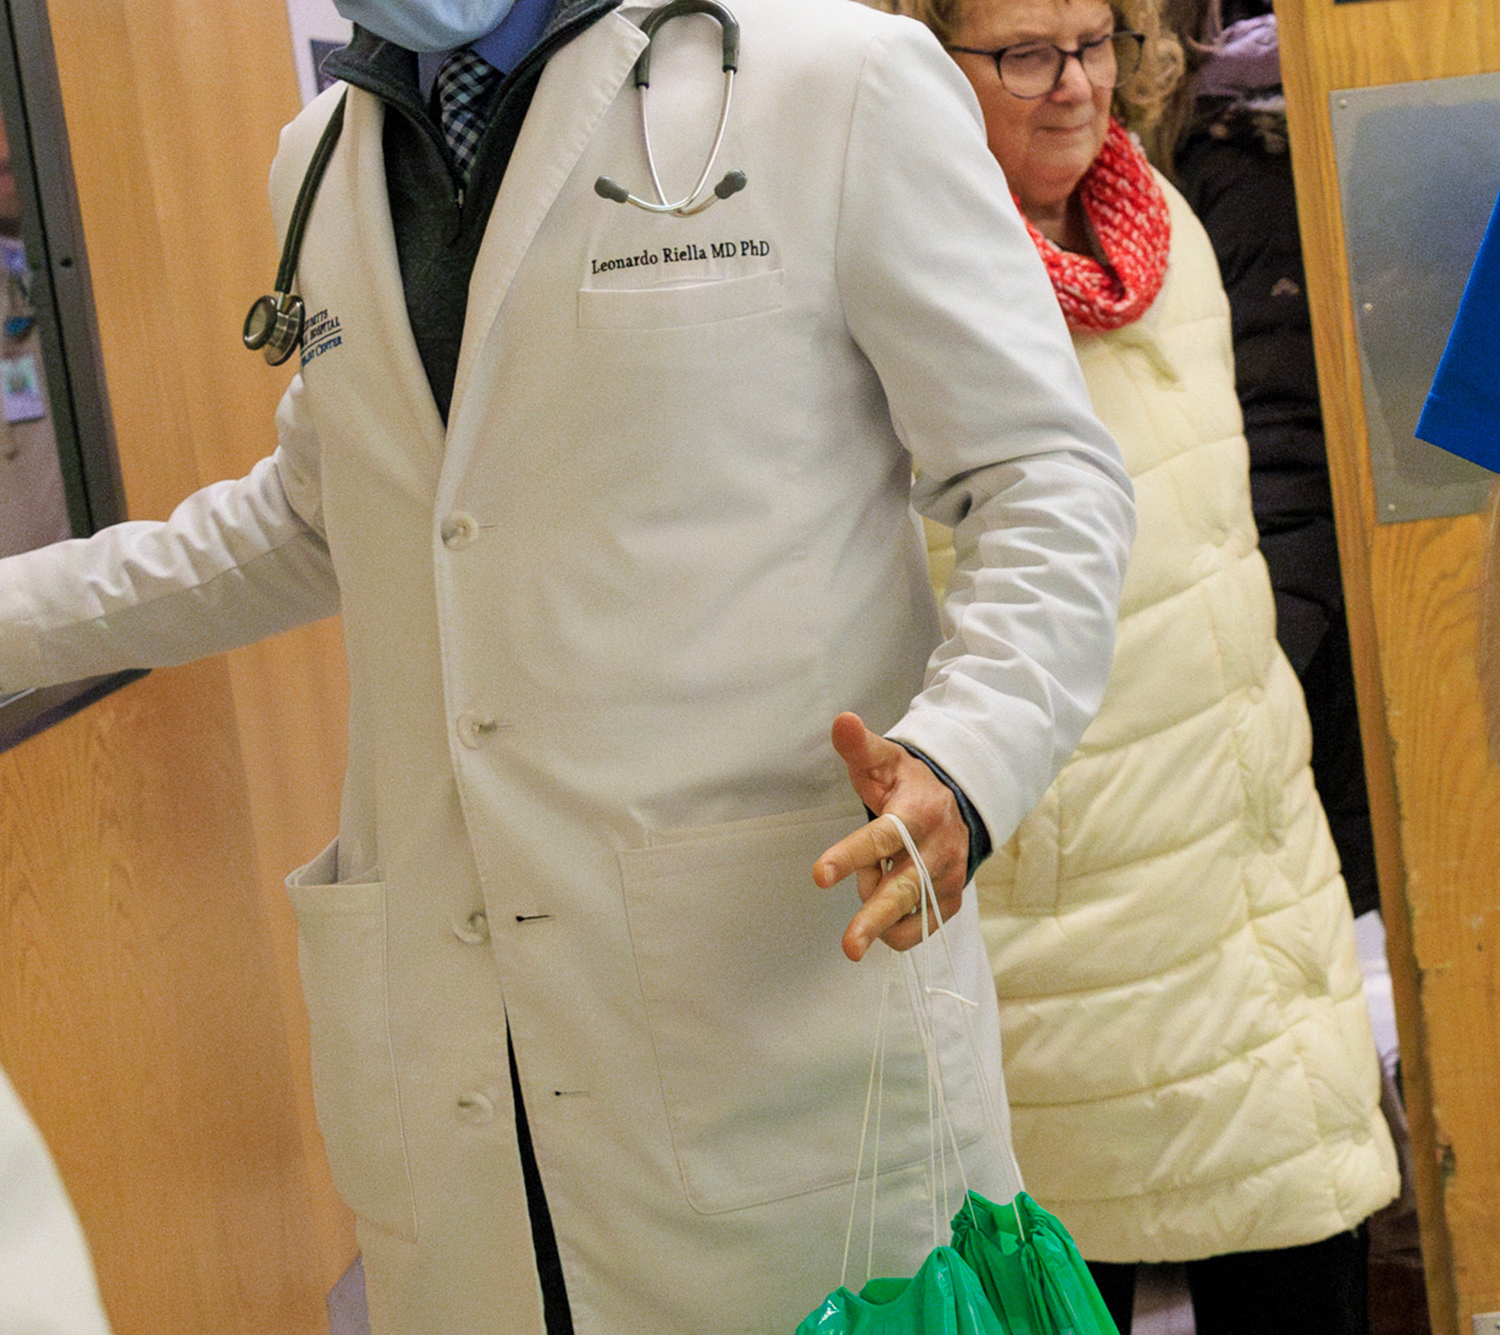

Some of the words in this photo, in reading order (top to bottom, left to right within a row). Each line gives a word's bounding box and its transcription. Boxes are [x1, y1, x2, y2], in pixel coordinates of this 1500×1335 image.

[591, 249, 660, 276] Leonardo
[662, 243, 708, 264] Riella
[710, 242, 738, 259] MD
[740, 239, 770, 257] PhD
